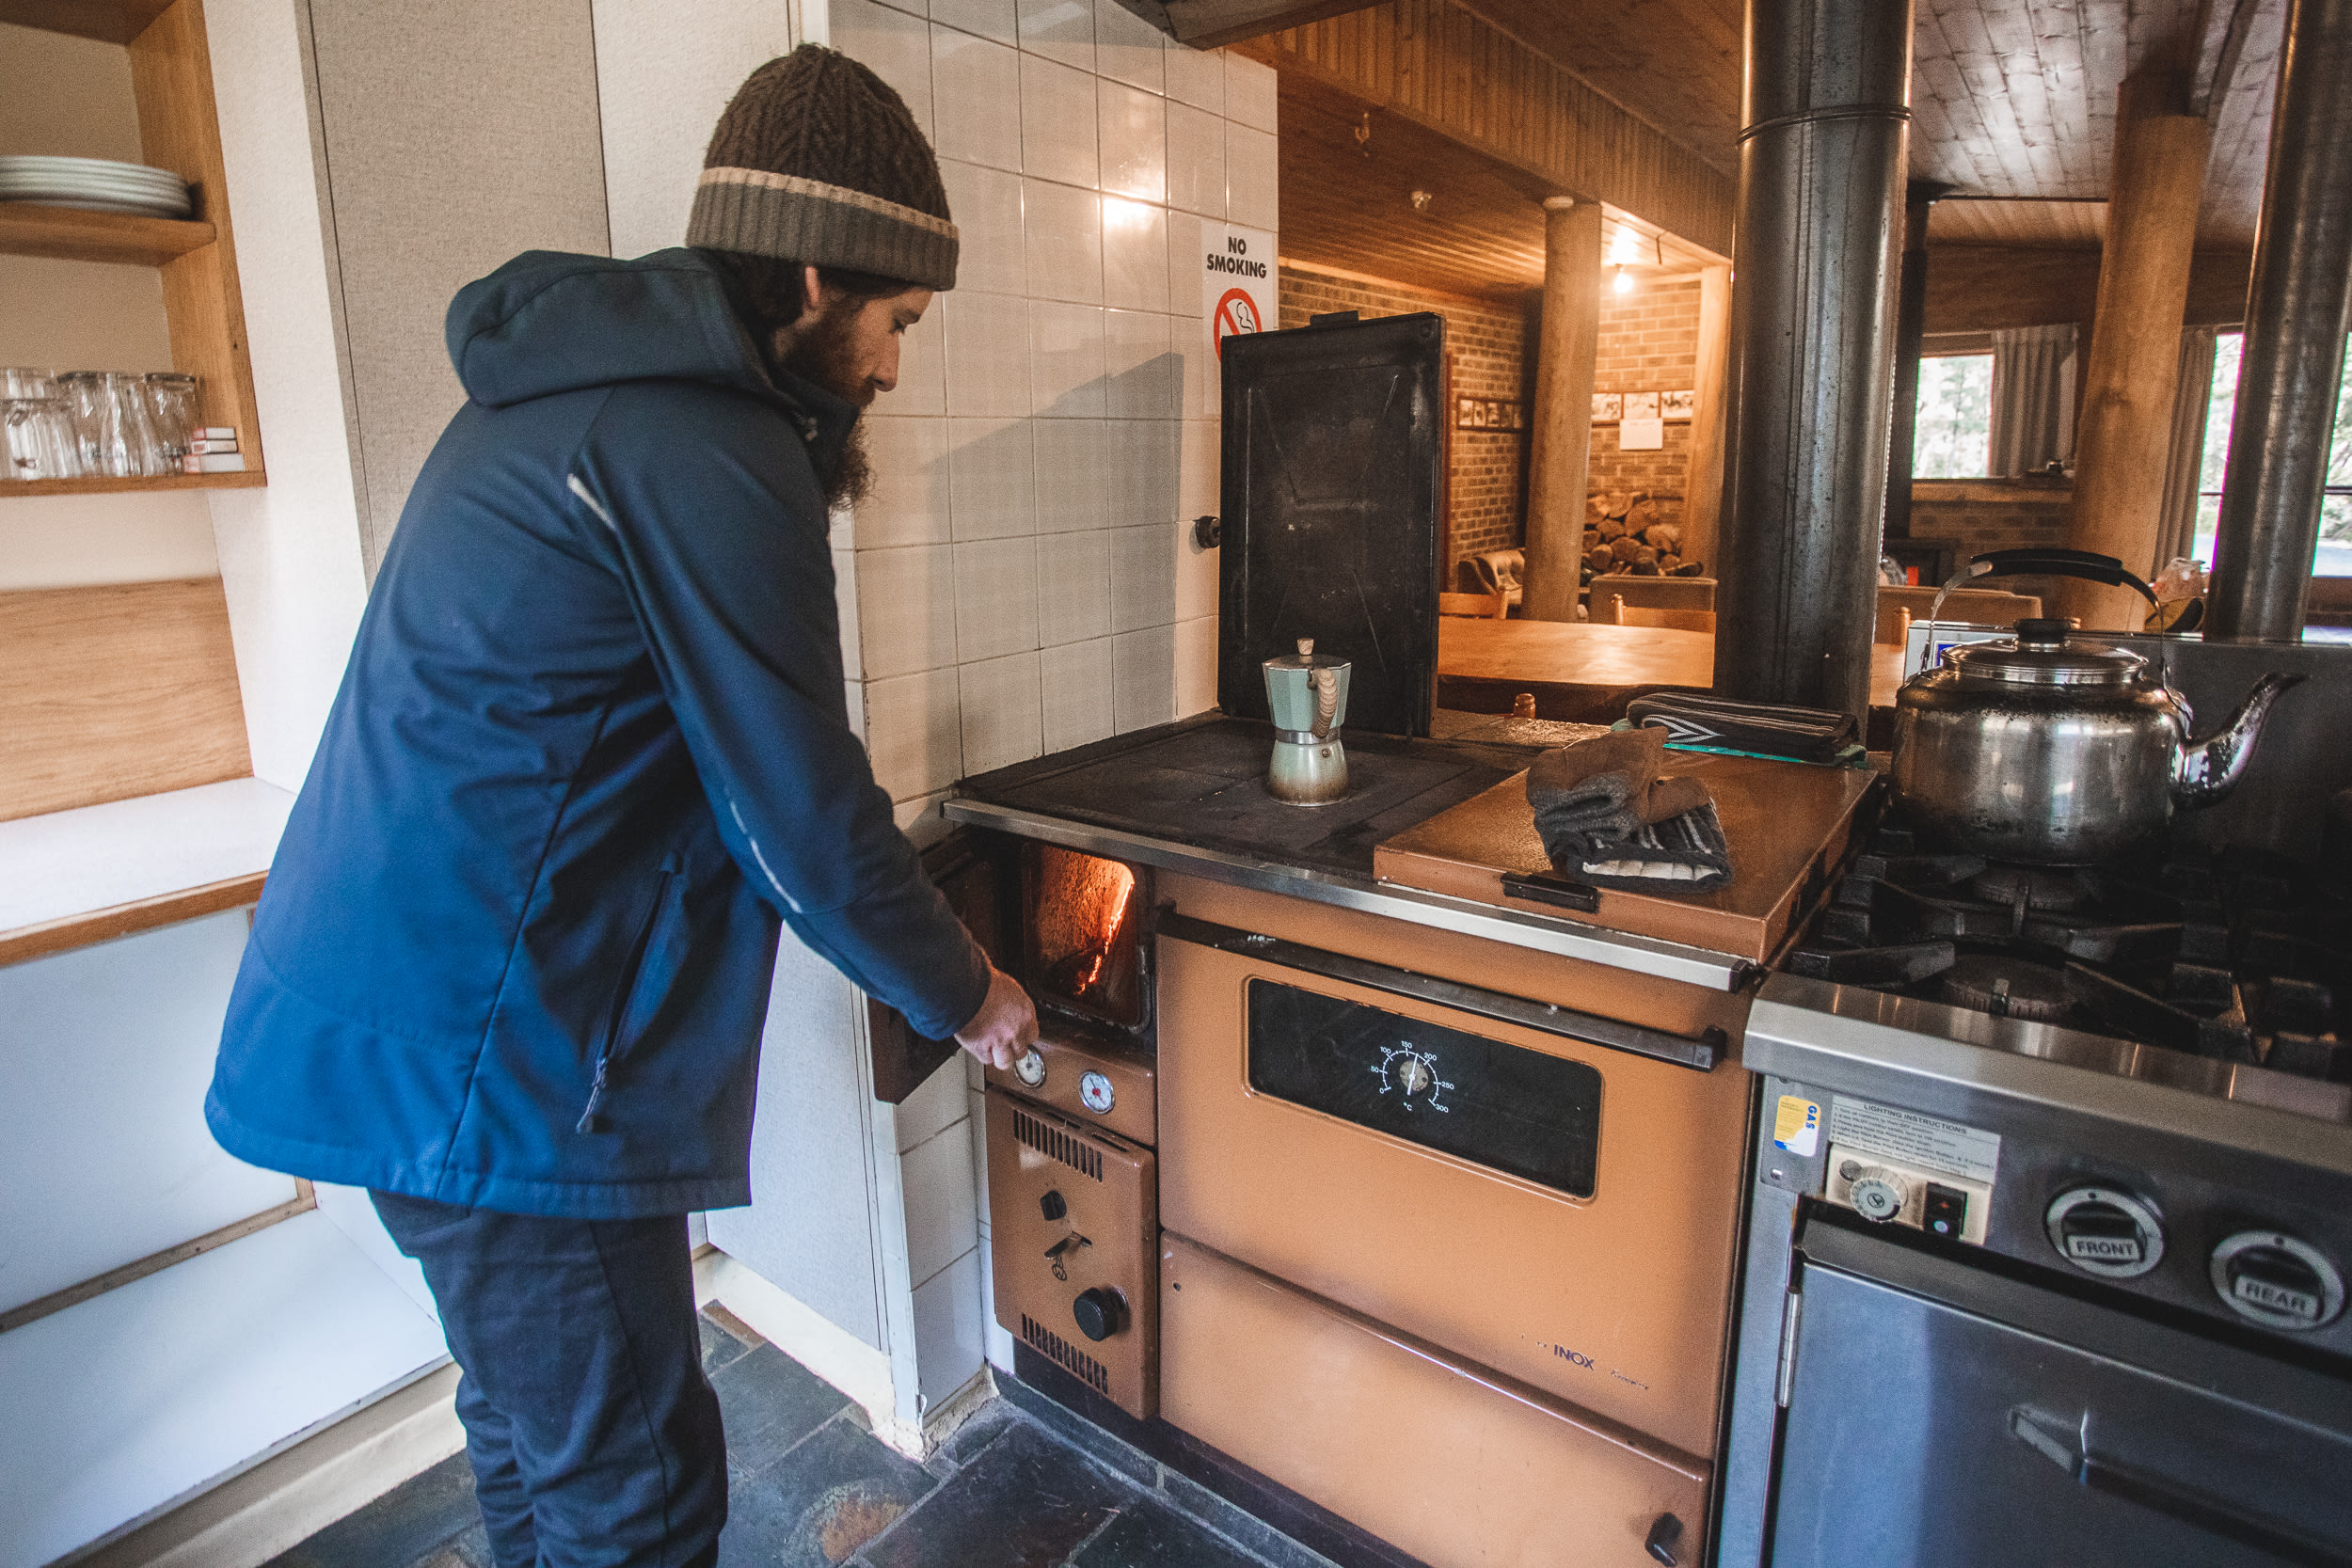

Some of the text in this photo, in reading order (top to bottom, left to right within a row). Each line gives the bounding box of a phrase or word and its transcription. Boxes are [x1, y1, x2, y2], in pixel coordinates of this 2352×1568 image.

[1228, 236, 1247, 255] NO
[1207, 253, 1267, 278] SMOKING
[1380, 1046, 1391, 1054] 100
[1423, 1052, 1438, 1062] 200
[1441, 1081, 1454, 1089] 250
[1435, 1103, 1449, 1113] 300
[1805, 1105, 1818, 1130] GAS
[1863, 1104, 1967, 1134] LIGHTING INSTRUCTIONS
[2075, 1240, 2135, 1257] FRONT
[2245, 1282, 2306, 1310] REAR
[1554, 1344, 1595, 1370] INOX
